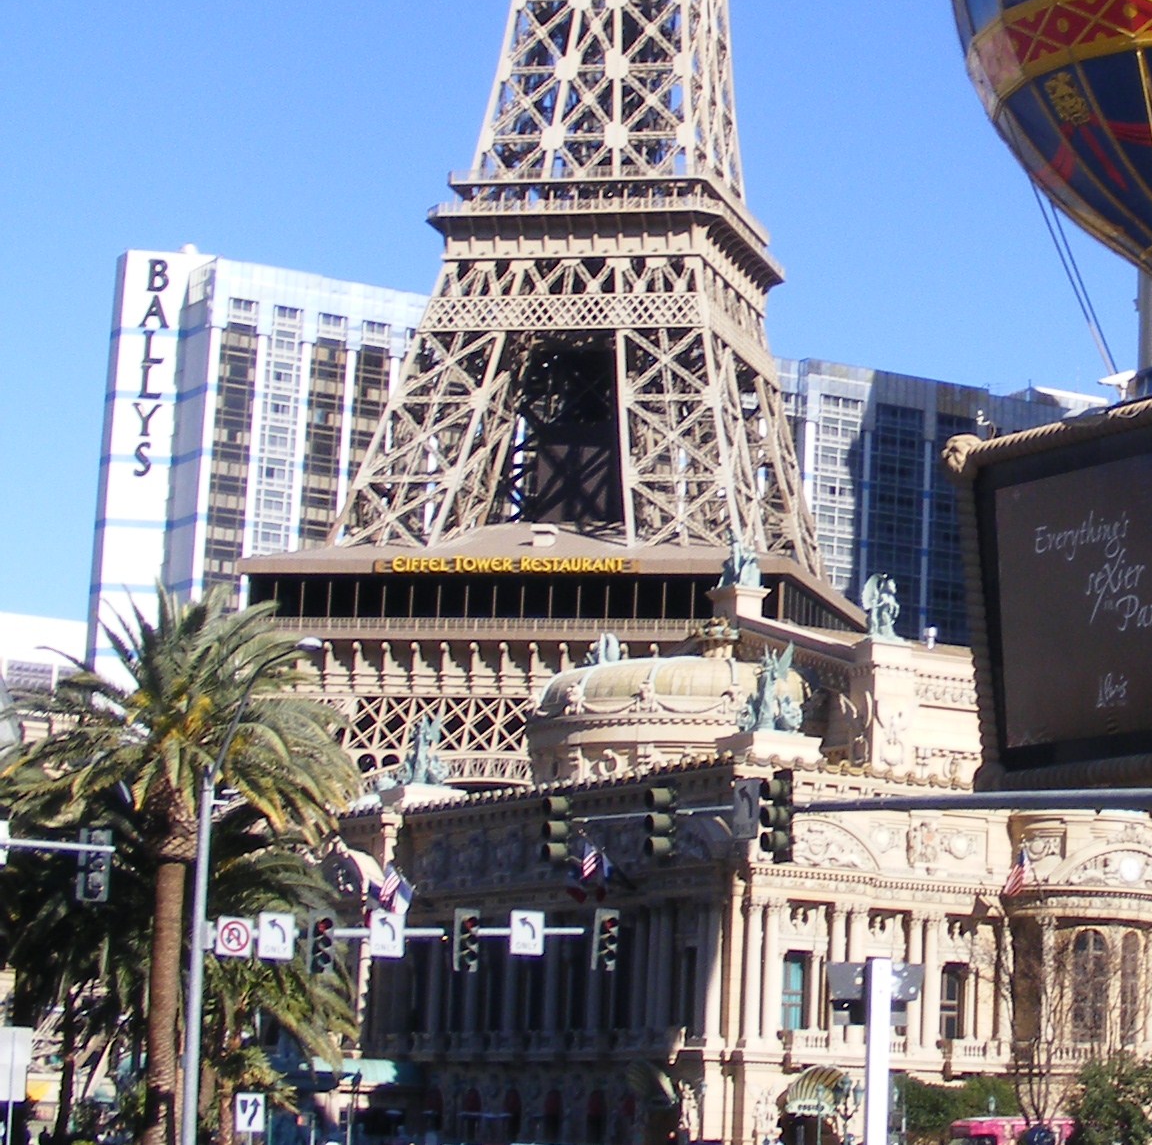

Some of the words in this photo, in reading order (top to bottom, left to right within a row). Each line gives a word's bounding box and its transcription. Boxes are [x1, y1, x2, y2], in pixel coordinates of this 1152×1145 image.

[133, 258, 169, 477] BALLYS
[1034, 510, 1130, 561] Everything's
[392, 556, 449, 572] EIFFEL
[454, 555, 514, 572] TOWER
[520, 556, 626, 572] RESTAURANT
[264, 943, 288, 954] ONLY
[374, 943, 398, 953] ONLY
